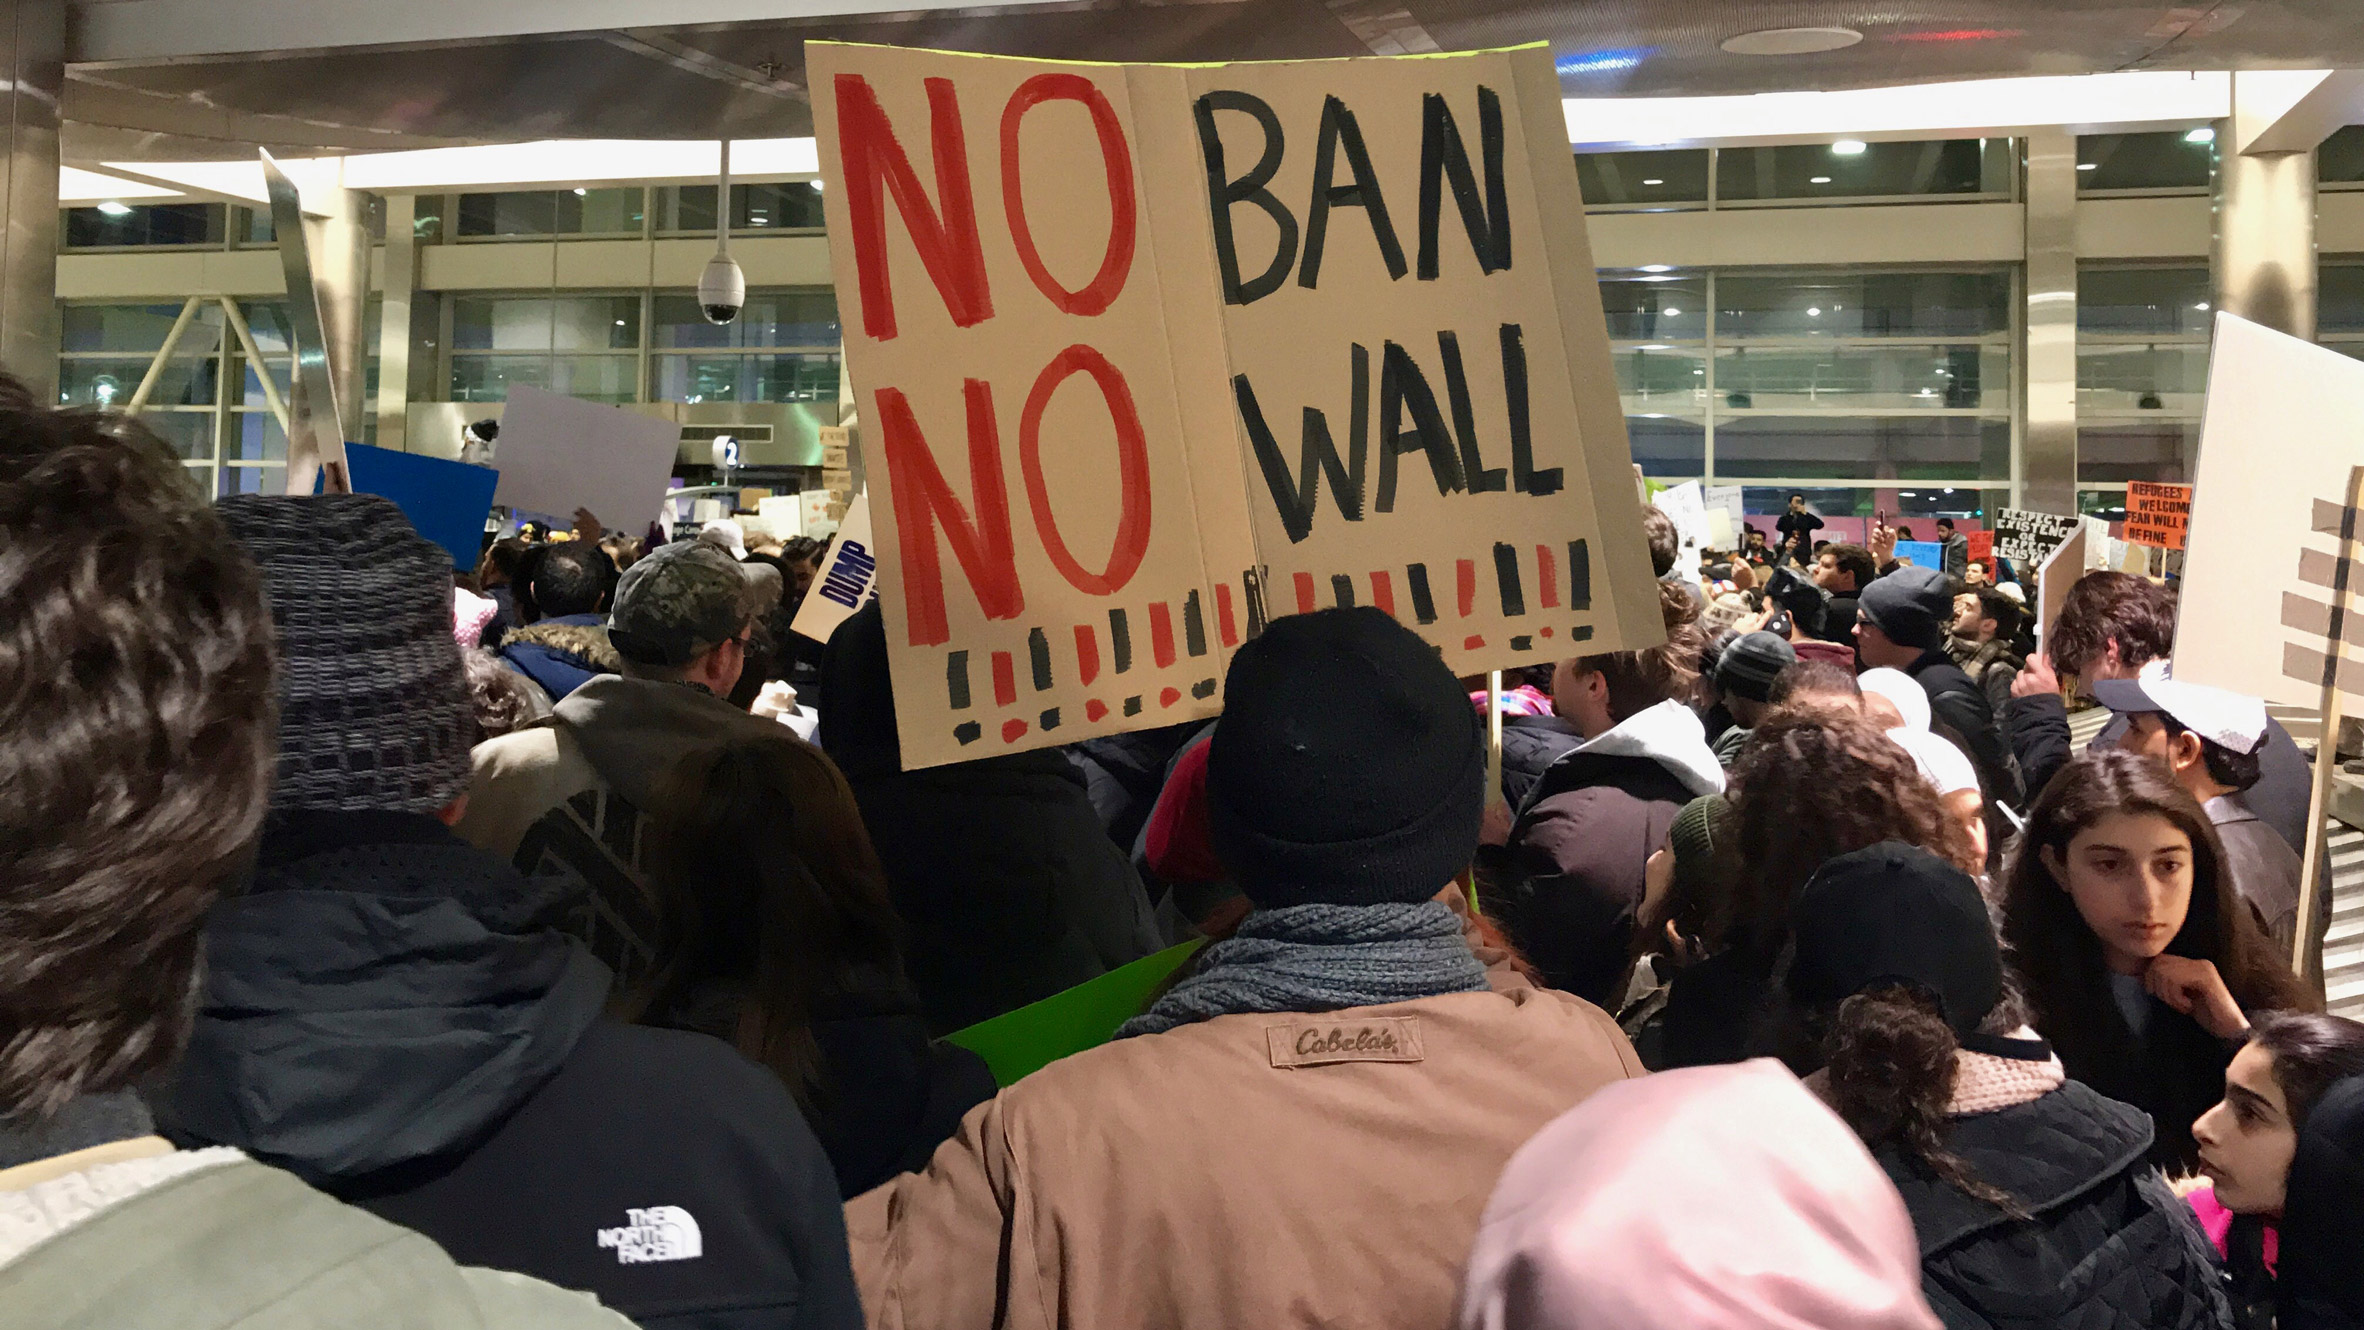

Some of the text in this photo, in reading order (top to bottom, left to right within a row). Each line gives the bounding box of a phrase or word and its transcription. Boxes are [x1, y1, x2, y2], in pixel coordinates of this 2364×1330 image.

[834, 72, 1513, 342] NO BAN
[726, 442, 737, 466] 2
[874, 323, 1564, 647] NO WALL
[2132, 483, 2183, 499] REFUGEES
[2002, 508, 2065, 527] RESPECT
[2126, 511, 2151, 525] FEAR
[2153, 514, 2179, 529] WILL
[2001, 537, 2059, 554] EXPECT
[2019, 532, 2036, 543] OR
[2128, 527, 2167, 545] DEFINE
[819, 539, 876, 610] DUMP
[1296, 1027, 1399, 1055] Cabela's
[625, 1208, 667, 1228] THE
[597, 1227, 665, 1248] NORTH
[618, 1243, 669, 1264] FACE
